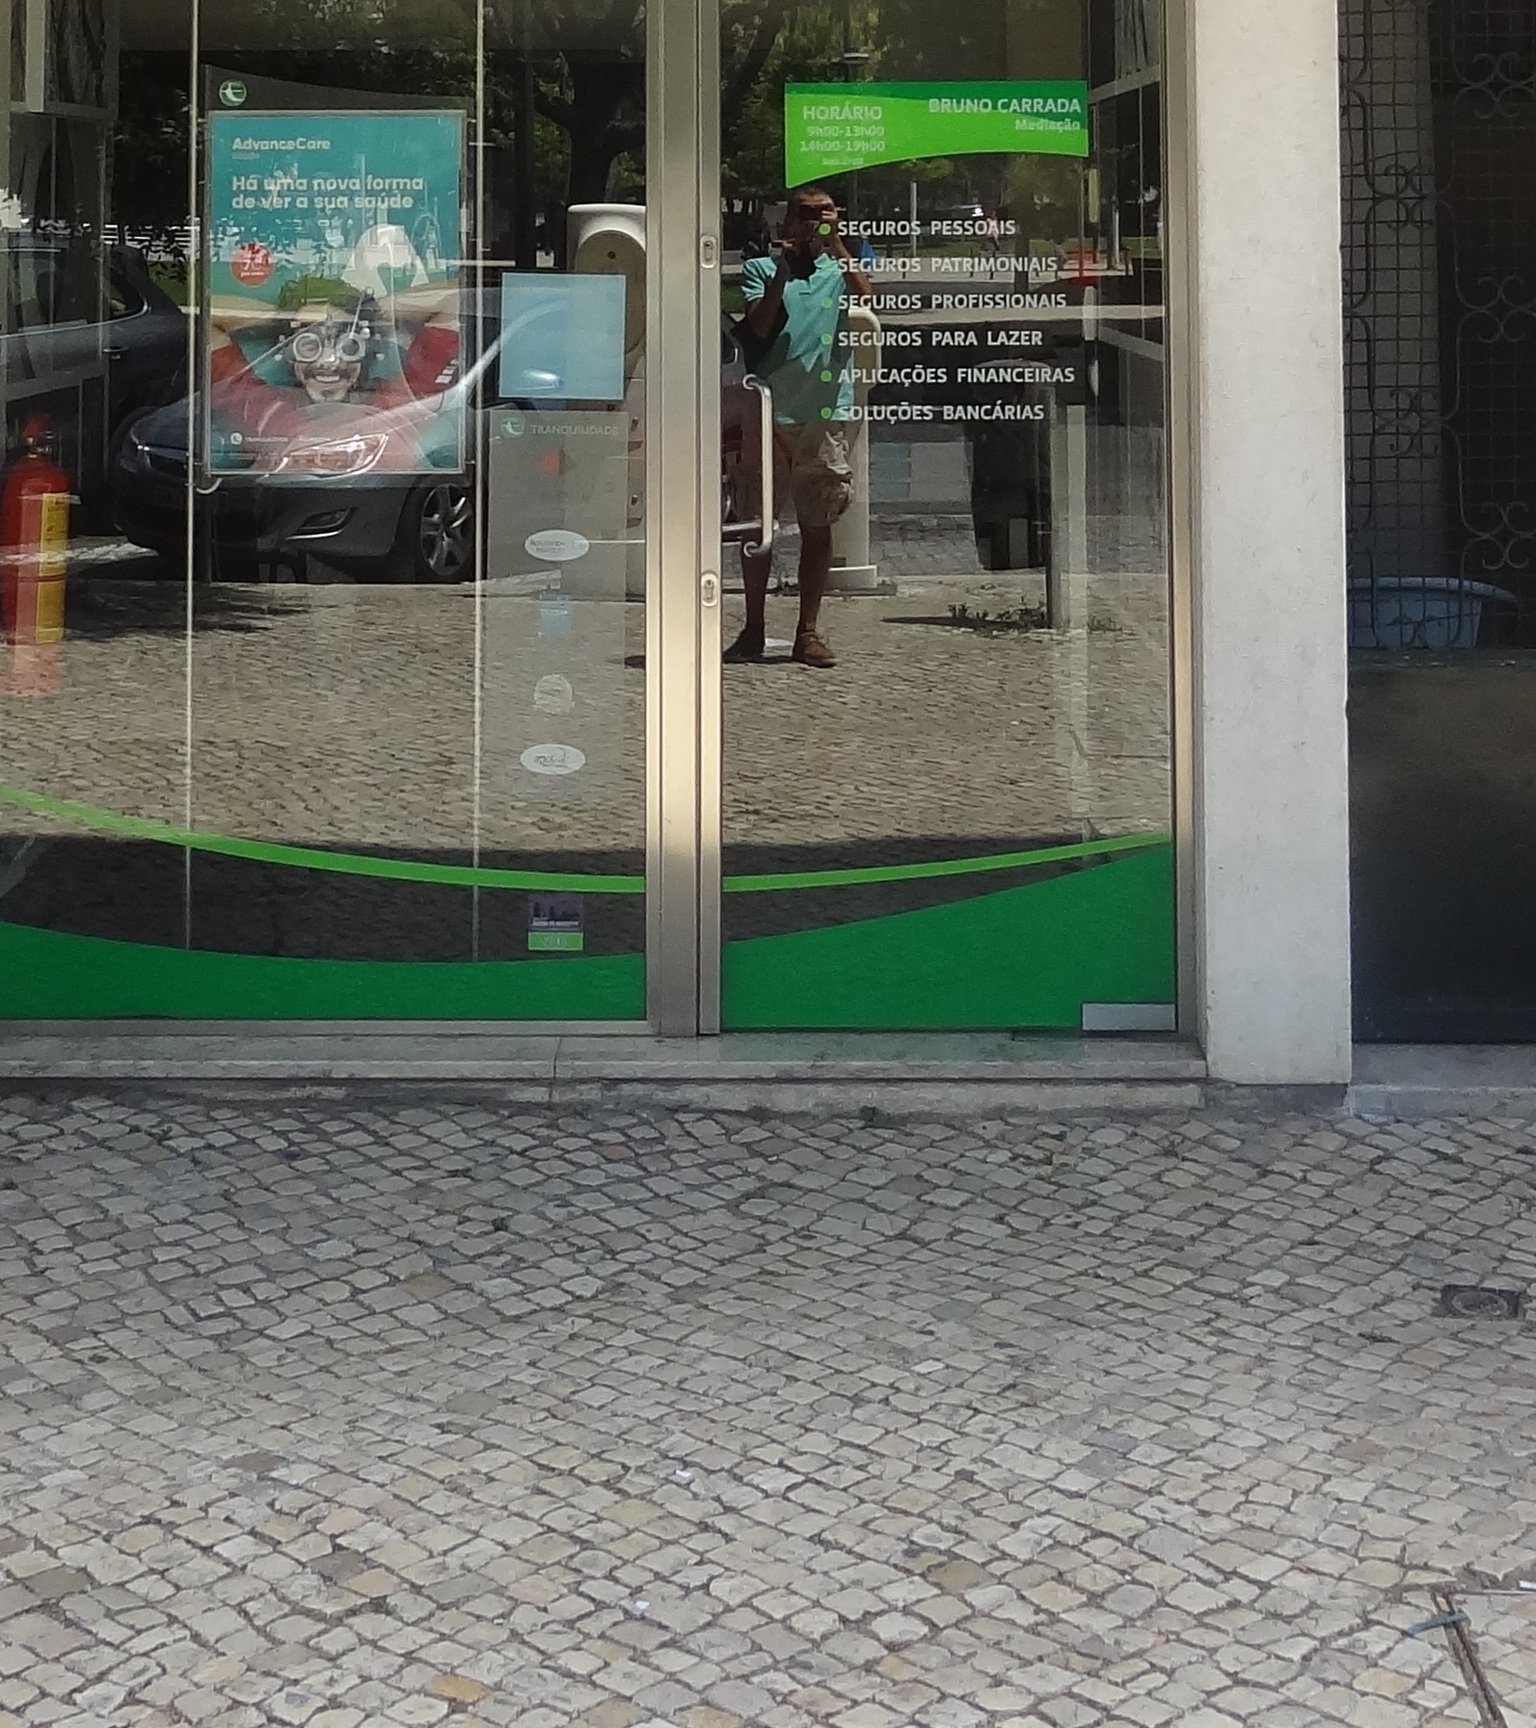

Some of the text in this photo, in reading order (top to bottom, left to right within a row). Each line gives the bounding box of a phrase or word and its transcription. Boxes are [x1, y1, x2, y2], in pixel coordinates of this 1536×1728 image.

[803, 101, 882, 121] HORÁRIO
[929, 98, 1081, 113] BRUNO CARRADA
[232, 137, 331, 151] AdvanceCare
[232, 174, 424, 191] Há uma nova forma
[232, 192, 414, 209] de ver a sua saúde
[837, 220, 1016, 236] SEGUROS PESSOAIS
[838, 256, 1058, 273] SEGUROS PATRIMONIAIS
[838, 293, 1067, 309] SEGUROS PROFISSIONAIS
[838, 331, 1043, 347] SEGUROS PARA LAZER
[838, 364, 1075, 387] APLICAÇÕES FINANCEIRAS
[838, 399, 1045, 424] SOLUÇÕES BANCÁRIAS
